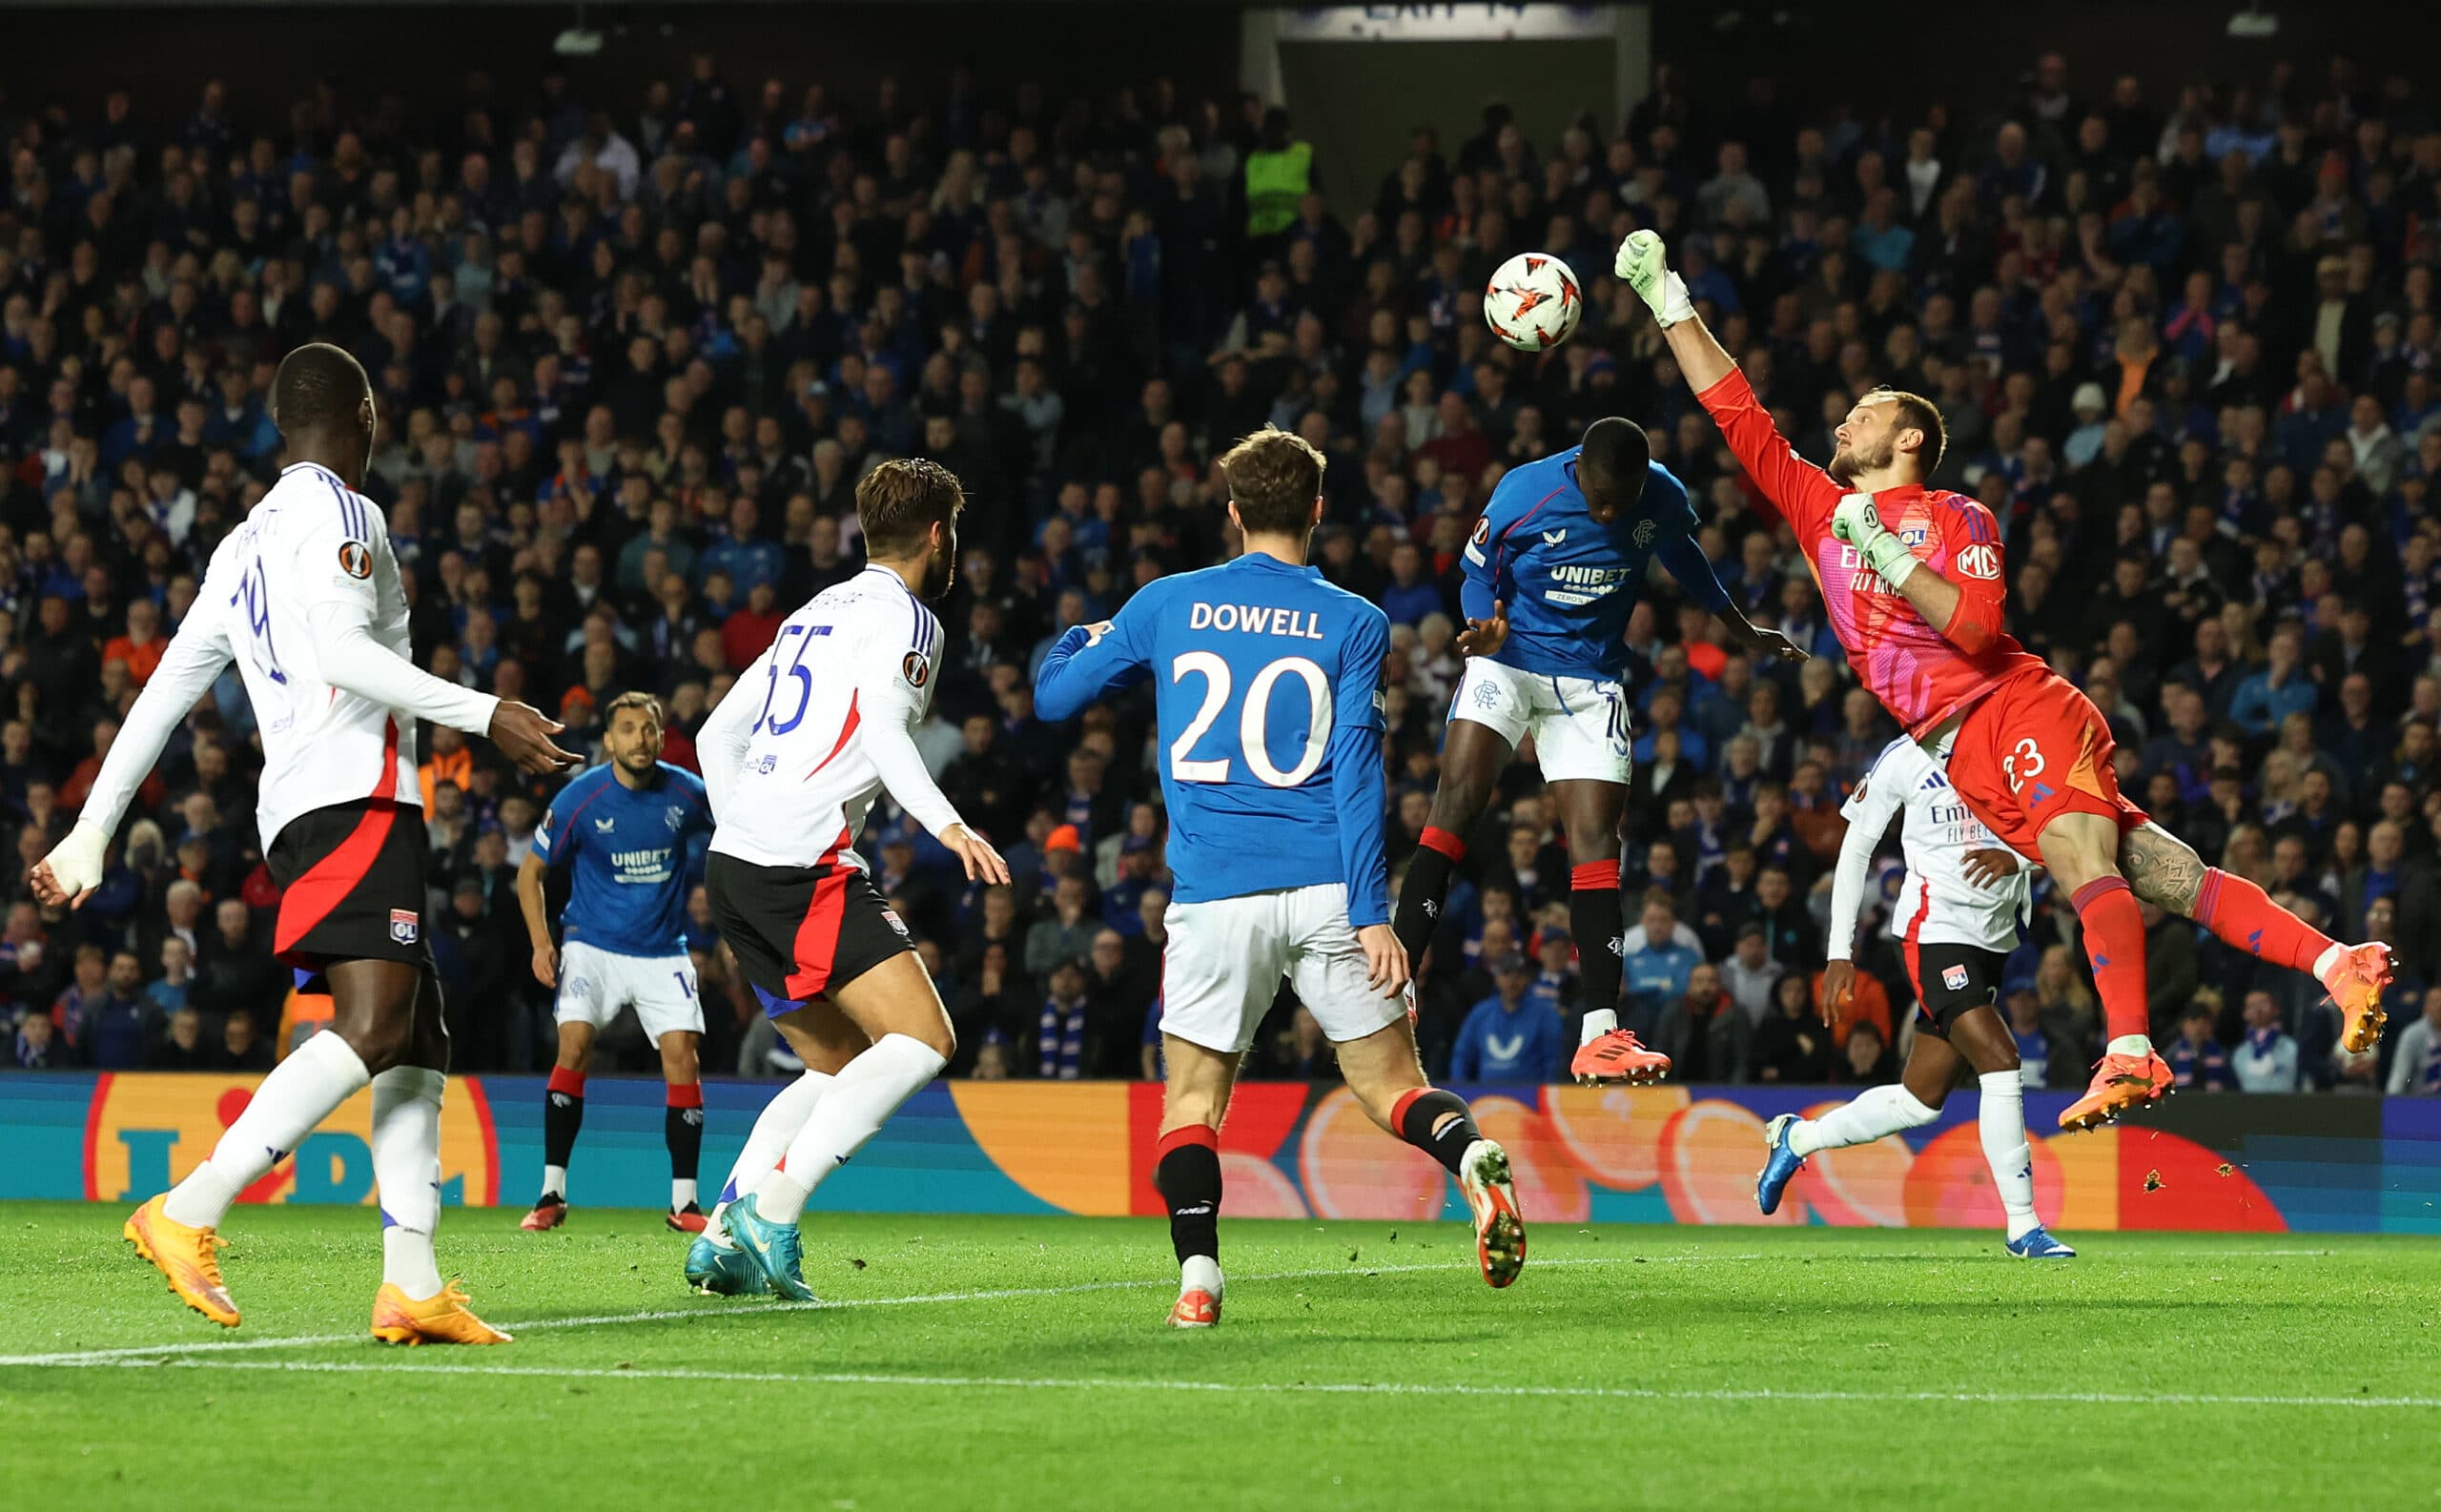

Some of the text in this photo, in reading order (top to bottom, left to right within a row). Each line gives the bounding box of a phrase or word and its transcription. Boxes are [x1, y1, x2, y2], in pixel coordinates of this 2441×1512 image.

[1961, 544, 2000, 577] MG
[1550, 565, 1631, 584] UNIBET
[1850, 572, 1873, 591] FLY
[1189, 603, 1323, 640] DOWELL
[1170, 650, 1332, 787] 20
[2003, 737, 2045, 795] 23
[1947, 827, 1965, 843] FLY
[611, 848, 672, 867] UNIBET
[395, 923, 415, 939] OL
